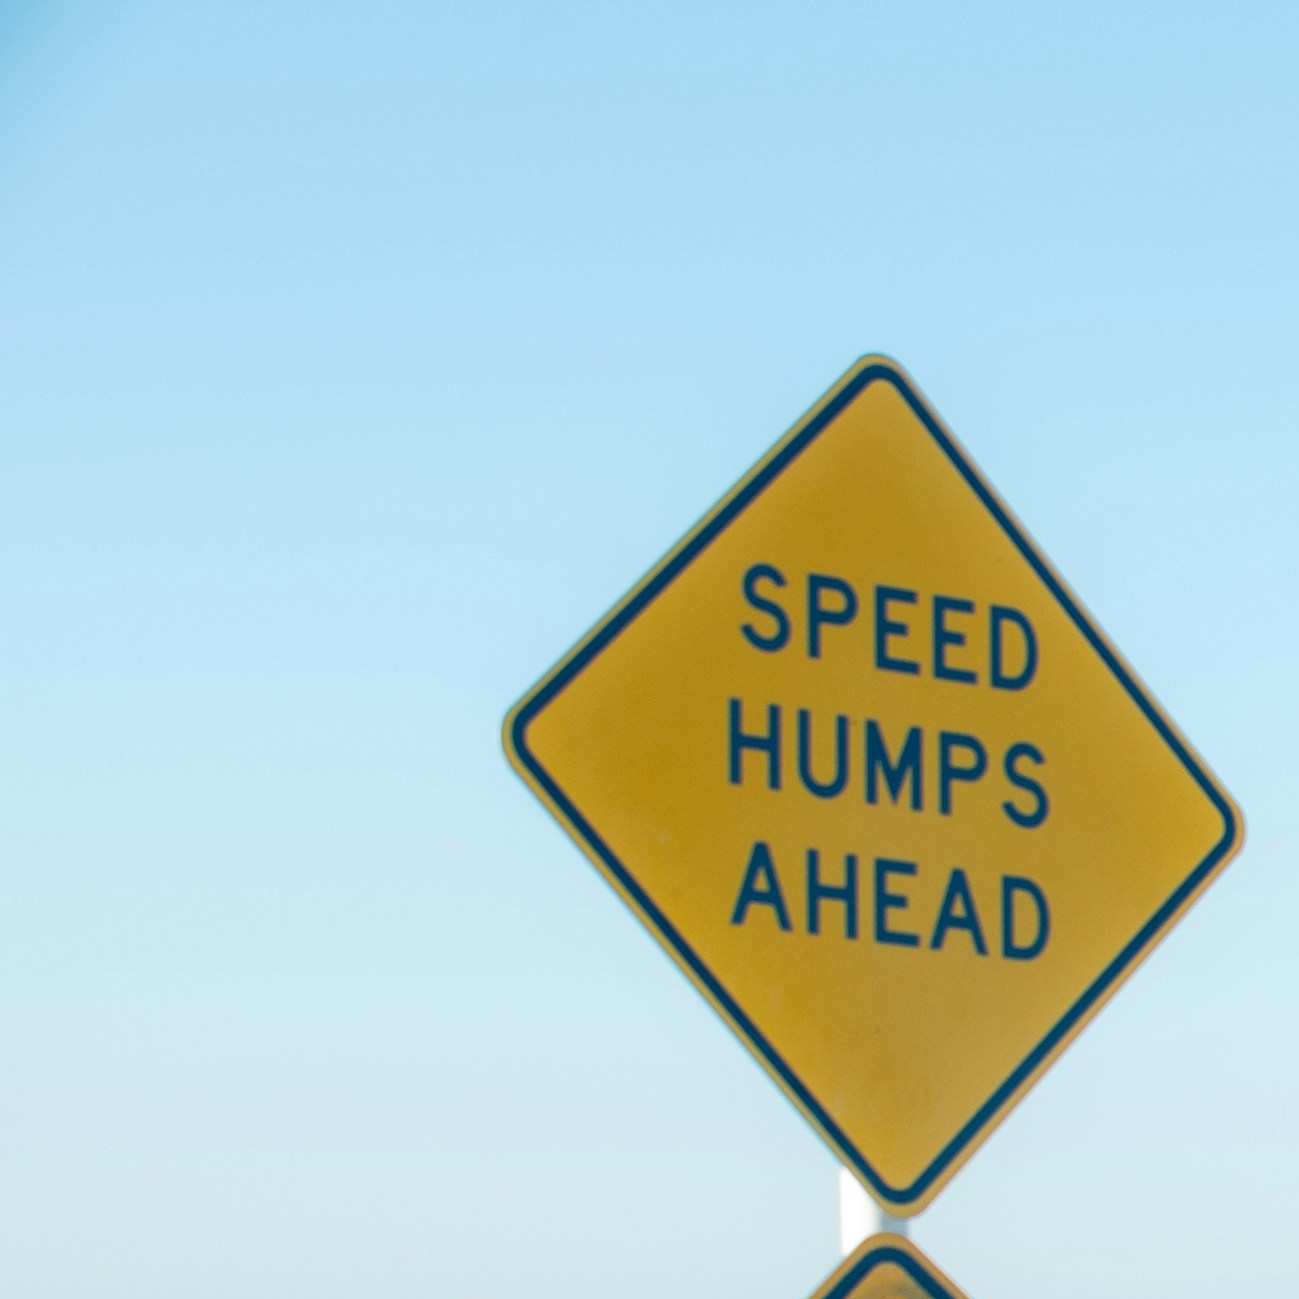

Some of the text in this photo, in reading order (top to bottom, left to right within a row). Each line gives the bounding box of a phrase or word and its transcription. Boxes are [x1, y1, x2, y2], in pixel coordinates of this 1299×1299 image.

[740, 562, 1038, 692] SPEED
[727, 697, 1049, 829] HUMPS
[730, 841, 1050, 961] AHEAD
